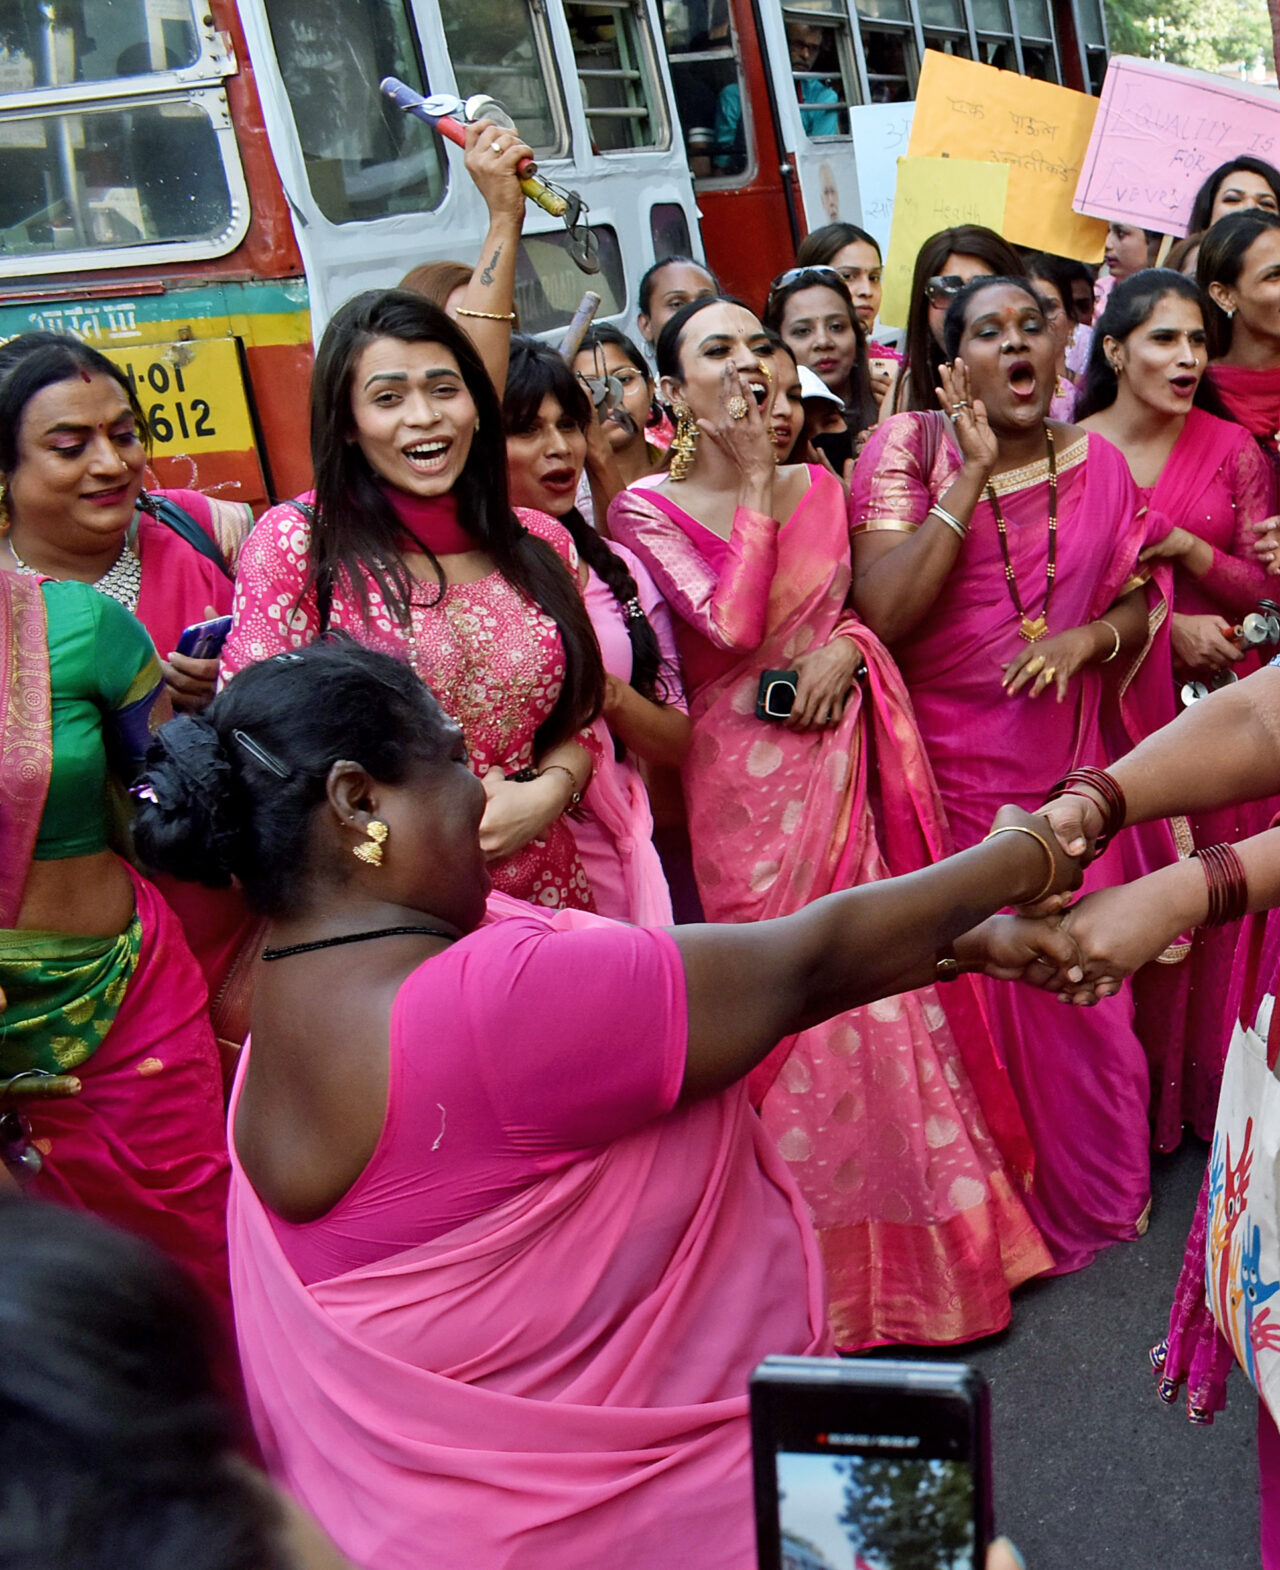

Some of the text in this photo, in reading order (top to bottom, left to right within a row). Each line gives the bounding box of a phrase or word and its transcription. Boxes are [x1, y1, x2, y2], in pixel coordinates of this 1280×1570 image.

[1246, 133, 1276, 152] IS
[1169, 149, 1210, 173] FOR
[148, 399, 216, 443] 612
